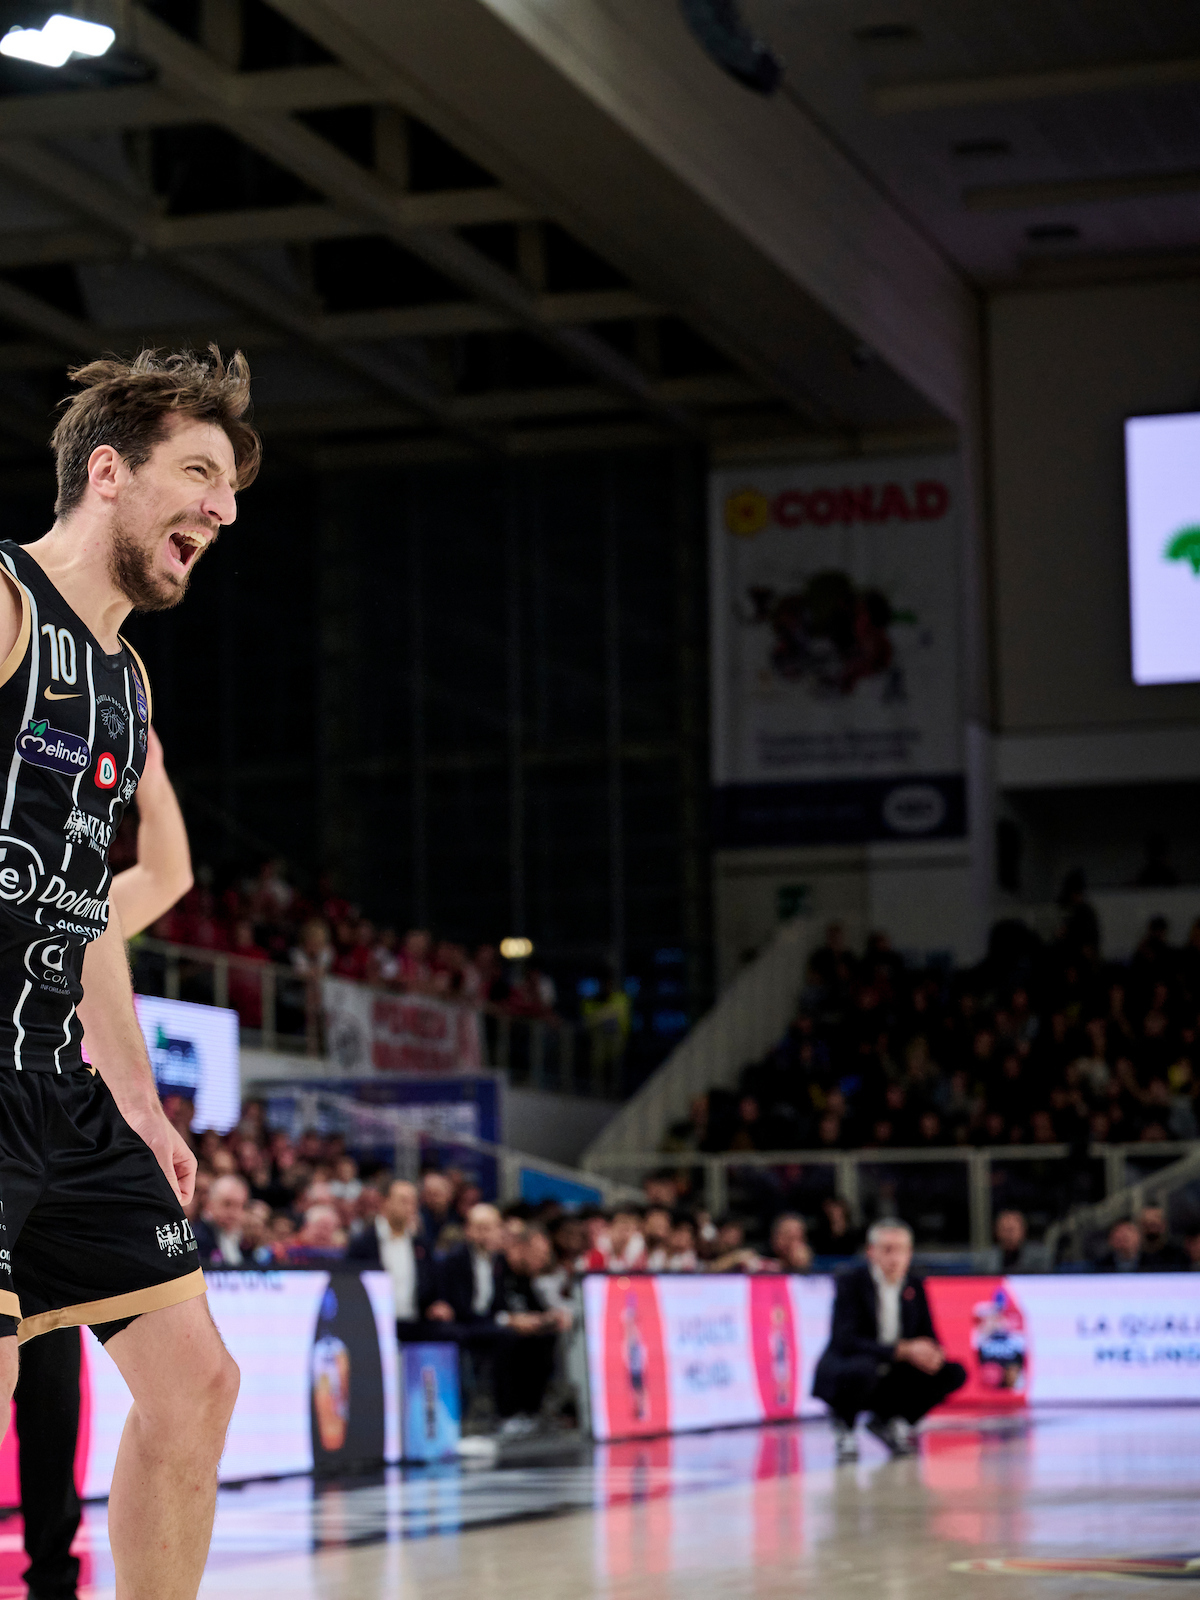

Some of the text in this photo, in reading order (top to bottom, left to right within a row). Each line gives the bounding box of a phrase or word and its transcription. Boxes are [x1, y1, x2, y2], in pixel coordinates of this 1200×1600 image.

[771, 480, 949, 527] CONAD
[40, 622, 78, 686] 10
[20, 734, 88, 768] Melinda
